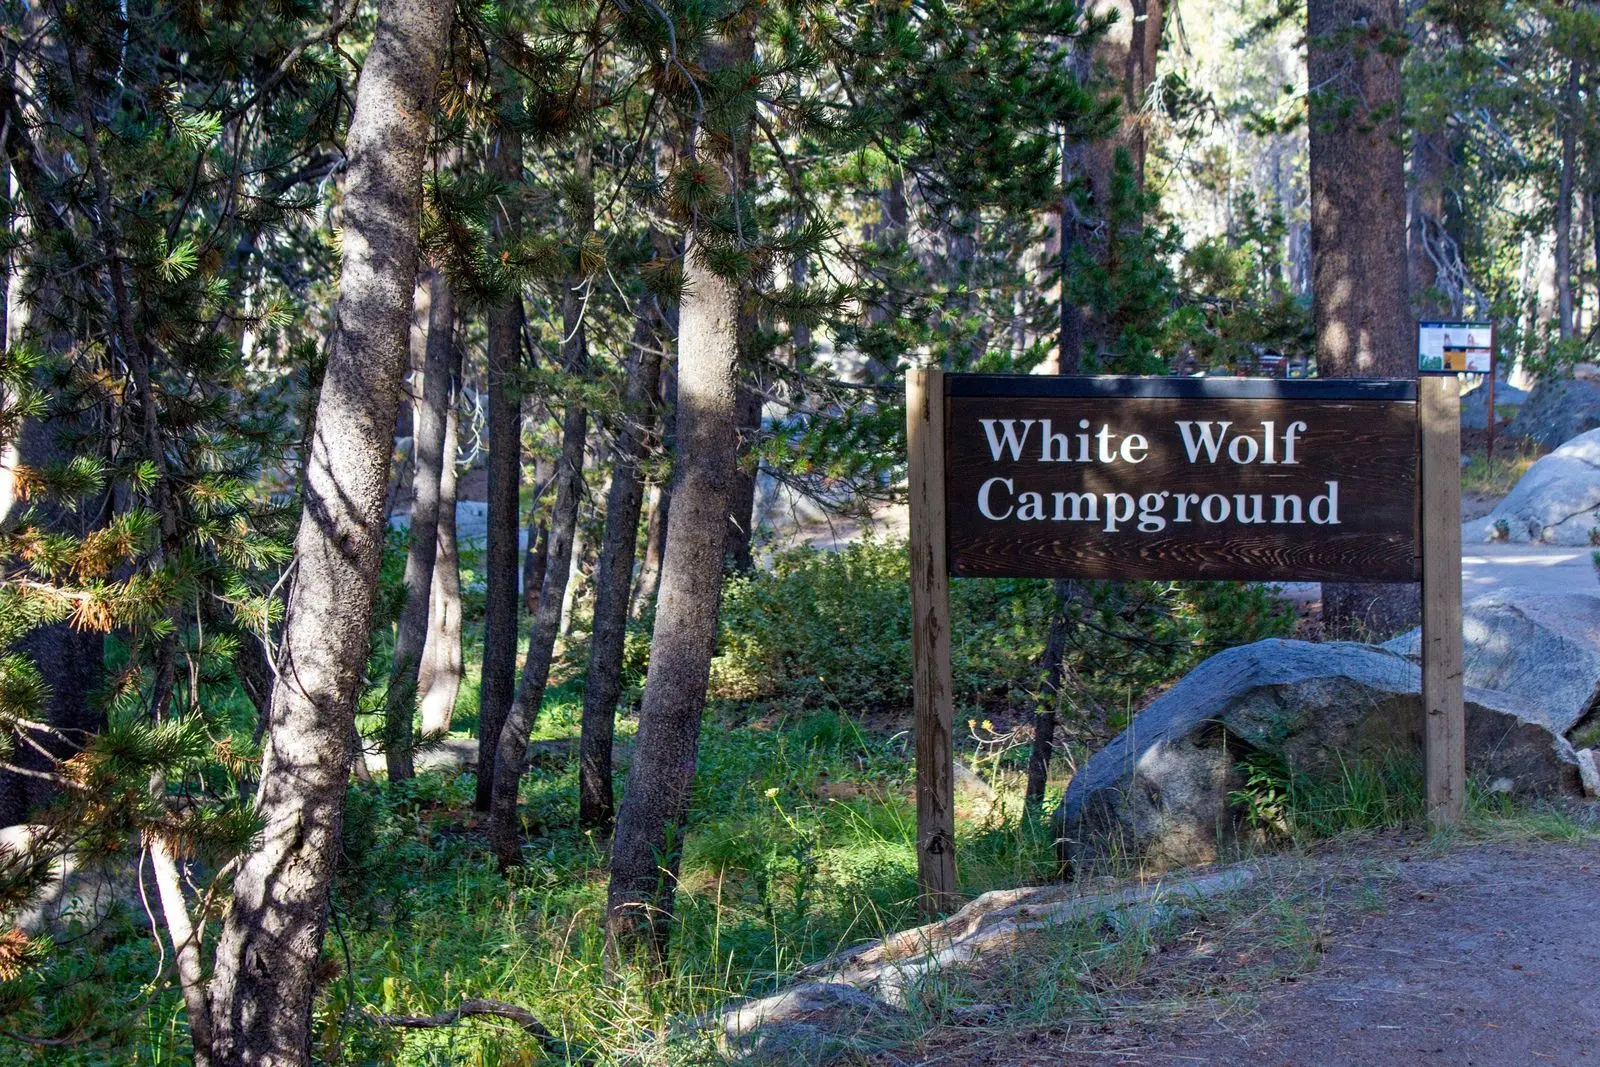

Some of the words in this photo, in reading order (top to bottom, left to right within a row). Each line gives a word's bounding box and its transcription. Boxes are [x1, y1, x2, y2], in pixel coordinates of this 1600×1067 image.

[978, 418, 1149, 464] White
[1174, 420, 1307, 465] Wolf
[977, 477, 1341, 533] Campground
